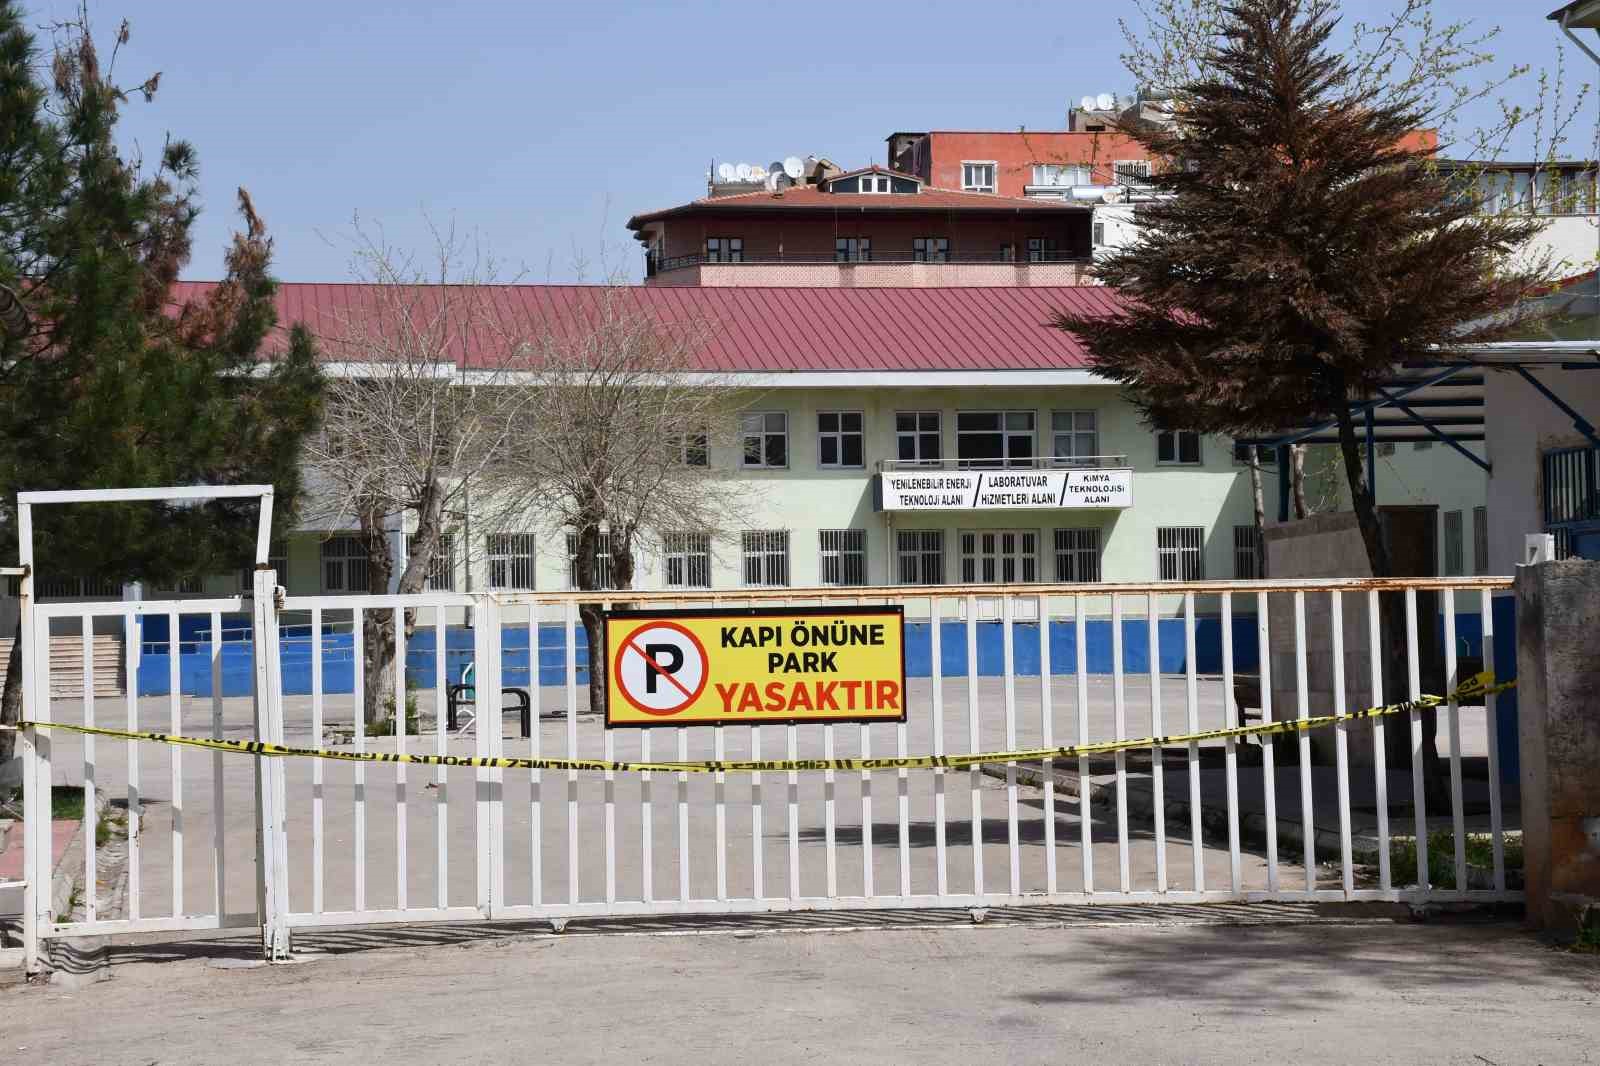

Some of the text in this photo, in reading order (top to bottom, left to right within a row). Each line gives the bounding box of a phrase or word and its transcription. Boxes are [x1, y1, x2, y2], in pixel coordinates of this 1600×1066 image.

[988, 475, 1048, 488] LABORATUVAR
[941, 494, 963, 506] ALANI
[1031, 493, 1056, 504] ALANI
[720, 620, 885, 648] KAPI ÖNÜNE
[768, 651, 838, 673] PARK
[715, 680, 900, 712] YASAKTIR
